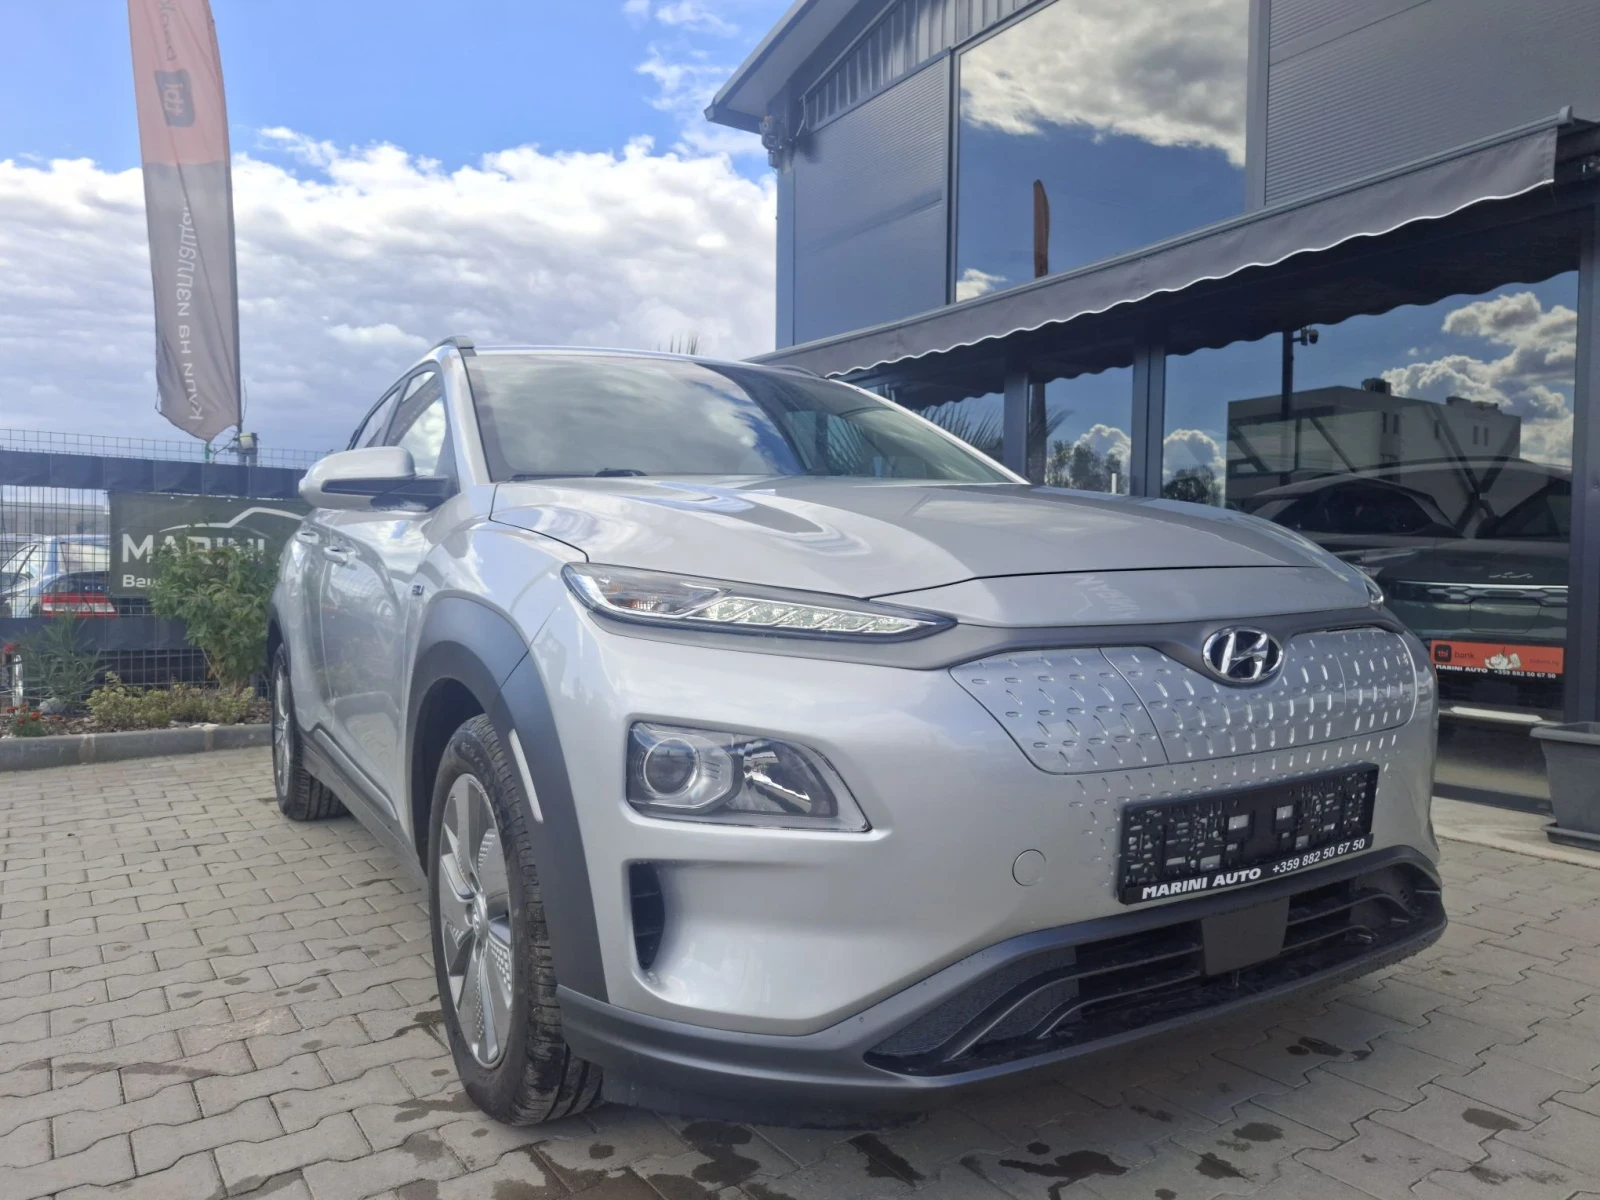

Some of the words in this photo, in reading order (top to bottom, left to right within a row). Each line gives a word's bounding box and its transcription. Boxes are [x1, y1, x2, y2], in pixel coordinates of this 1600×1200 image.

[1454, 650, 1475, 659] bank
[1436, 664, 1463, 672] MARINI
[1142, 877, 1207, 899] MARINI
[1212, 867, 1262, 887] AUTO
[1272, 858, 1300, 874] +359
[1302, 851, 1321, 866] 882
[1323, 846, 1335, 859] 50
[1337, 843, 1350, 856] 67
[1353, 838, 1365, 852] 50
